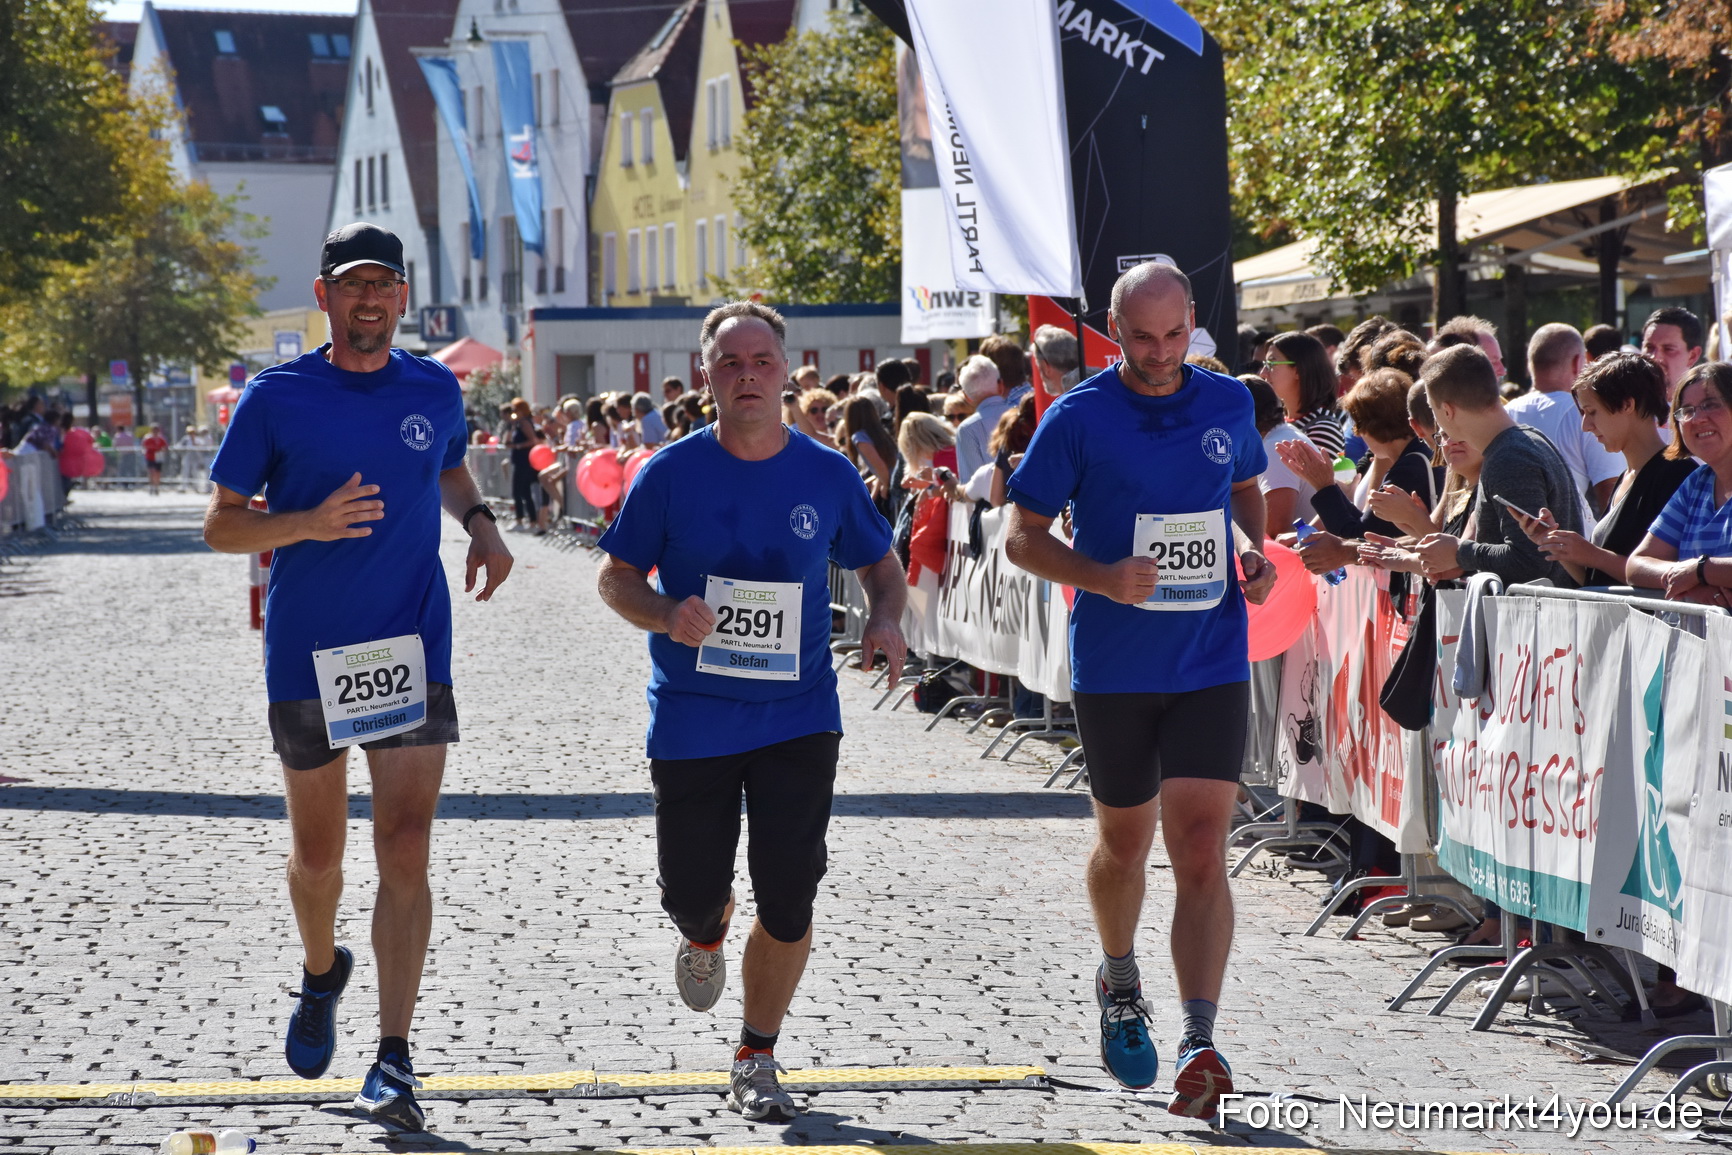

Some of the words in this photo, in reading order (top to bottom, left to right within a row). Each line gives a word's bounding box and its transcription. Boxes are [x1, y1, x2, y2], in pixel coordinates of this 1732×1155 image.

[1104, 355, 1122, 366] TH
[1164, 521, 1206, 534] BOCK
[1149, 538, 1216, 570] 2588
[733, 588, 777, 602] BOCK
[1161, 587, 1208, 600] Thomas
[716, 606, 784, 638] 2591
[721, 639, 742, 647] PARTL
[345, 648, 393, 665] BOCK
[730, 653, 768, 668] Stefan
[335, 664, 412, 705] 2592
[346, 705, 369, 714] PARTL
[370, 700, 400, 711] Neumarkt
[352, 712, 406, 734] Christian
[1717, 751, 1732, 793] N
[1616, 907, 1640, 932] Jura
